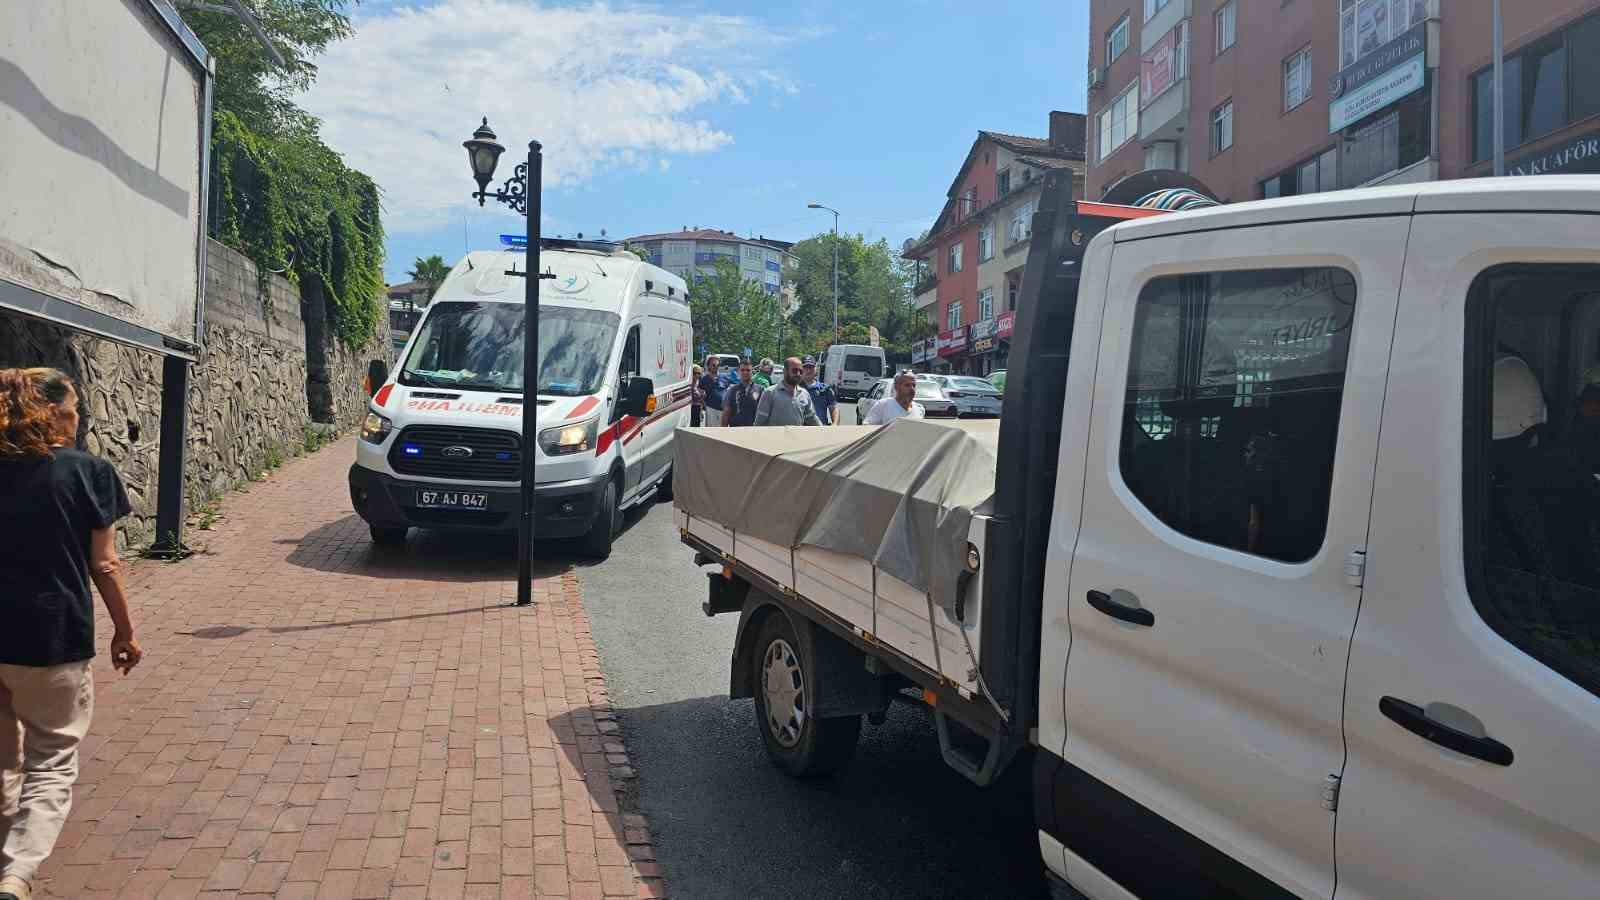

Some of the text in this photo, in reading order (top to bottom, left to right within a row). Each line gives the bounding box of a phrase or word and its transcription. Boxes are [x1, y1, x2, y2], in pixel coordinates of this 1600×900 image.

[1531, 139, 1600, 176] KUAFÖR
[422, 491, 486, 506] 67 AJ 847
